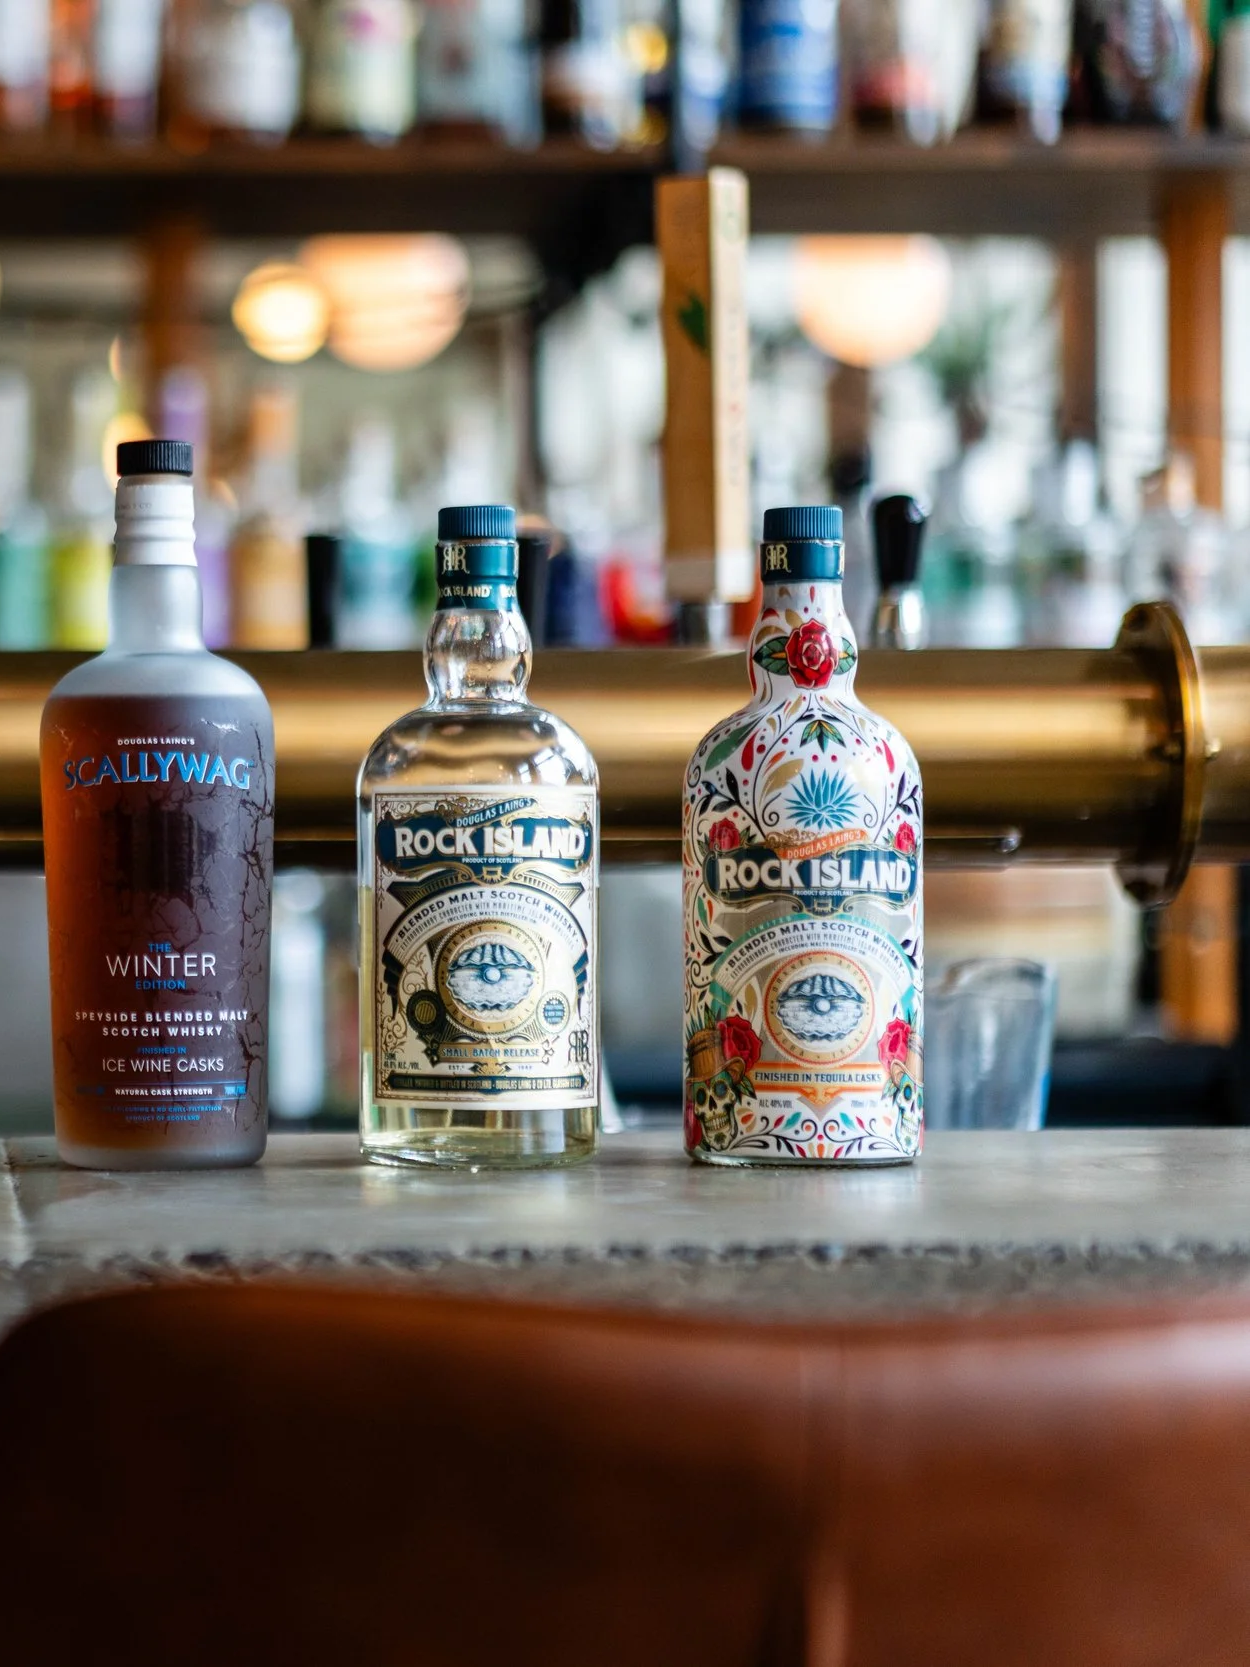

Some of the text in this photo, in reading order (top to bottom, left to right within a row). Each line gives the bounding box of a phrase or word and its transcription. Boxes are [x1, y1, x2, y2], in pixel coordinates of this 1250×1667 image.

[453, 585, 490, 598] ISLAND
[117, 737, 195, 746] DOUGLAS LAING'S
[63, 751, 251, 791] SCALLYWAG
[456, 797, 533, 828] DOUGLAS LAING'S
[394, 825, 586, 860] ROCK ISLAND
[787, 829, 863, 859] DOUGLAS LAING'S
[717, 858, 913, 892] ROCK ISLAND
[397, 900, 446, 939] BLENDED
[448, 891, 485, 905] MALT
[490, 890, 541, 907] SCOTCH
[544, 903, 578, 938] WHISKY
[447, 911, 478, 923] INCLUDING
[148, 942, 172, 953] THE
[727, 931, 776, 969] BLENDED
[780, 922, 816, 936] MALT
[821, 921, 870, 939] SCOTCH
[873, 934, 903, 968] WHISKY
[778, 942, 809, 953] INCLUDING
[105, 953, 217, 978] WINTER
[135, 979, 187, 990] EDITION
[74, 1009, 248, 1023] SPEYSIDE BLENDED MALT
[102, 1025, 223, 1037] SCOTCH WHISKY
[177, 1046, 187, 1054] IN
[442, 1047, 540, 1058] SMALL BATCH RELEASE
[102, 1057, 225, 1073] ICE WINE CASKS
[754, 1071, 883, 1083] FINISHED IN TEQUILA CASKS
[115, 1087, 213, 1096] NATURAL CASK STRENGTH
